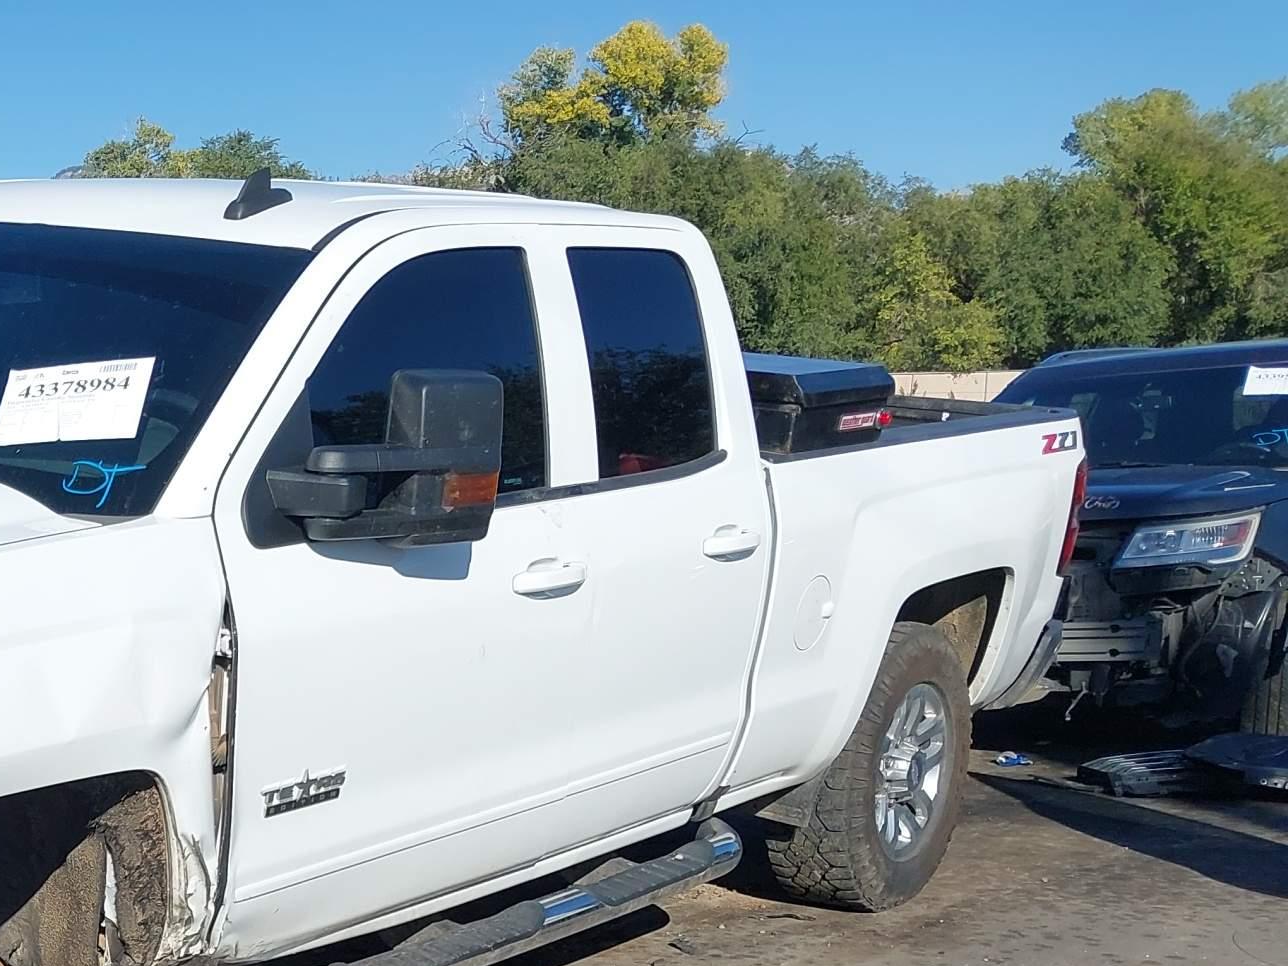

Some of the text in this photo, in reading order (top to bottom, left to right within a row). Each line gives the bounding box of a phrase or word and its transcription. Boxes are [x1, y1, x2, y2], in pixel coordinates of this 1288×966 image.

[18, 376, 131, 399] 43378984
[1041, 431, 1078, 455] Z71
[261, 769, 346, 805] TEXAS
[268, 790, 338, 814] EDITION
